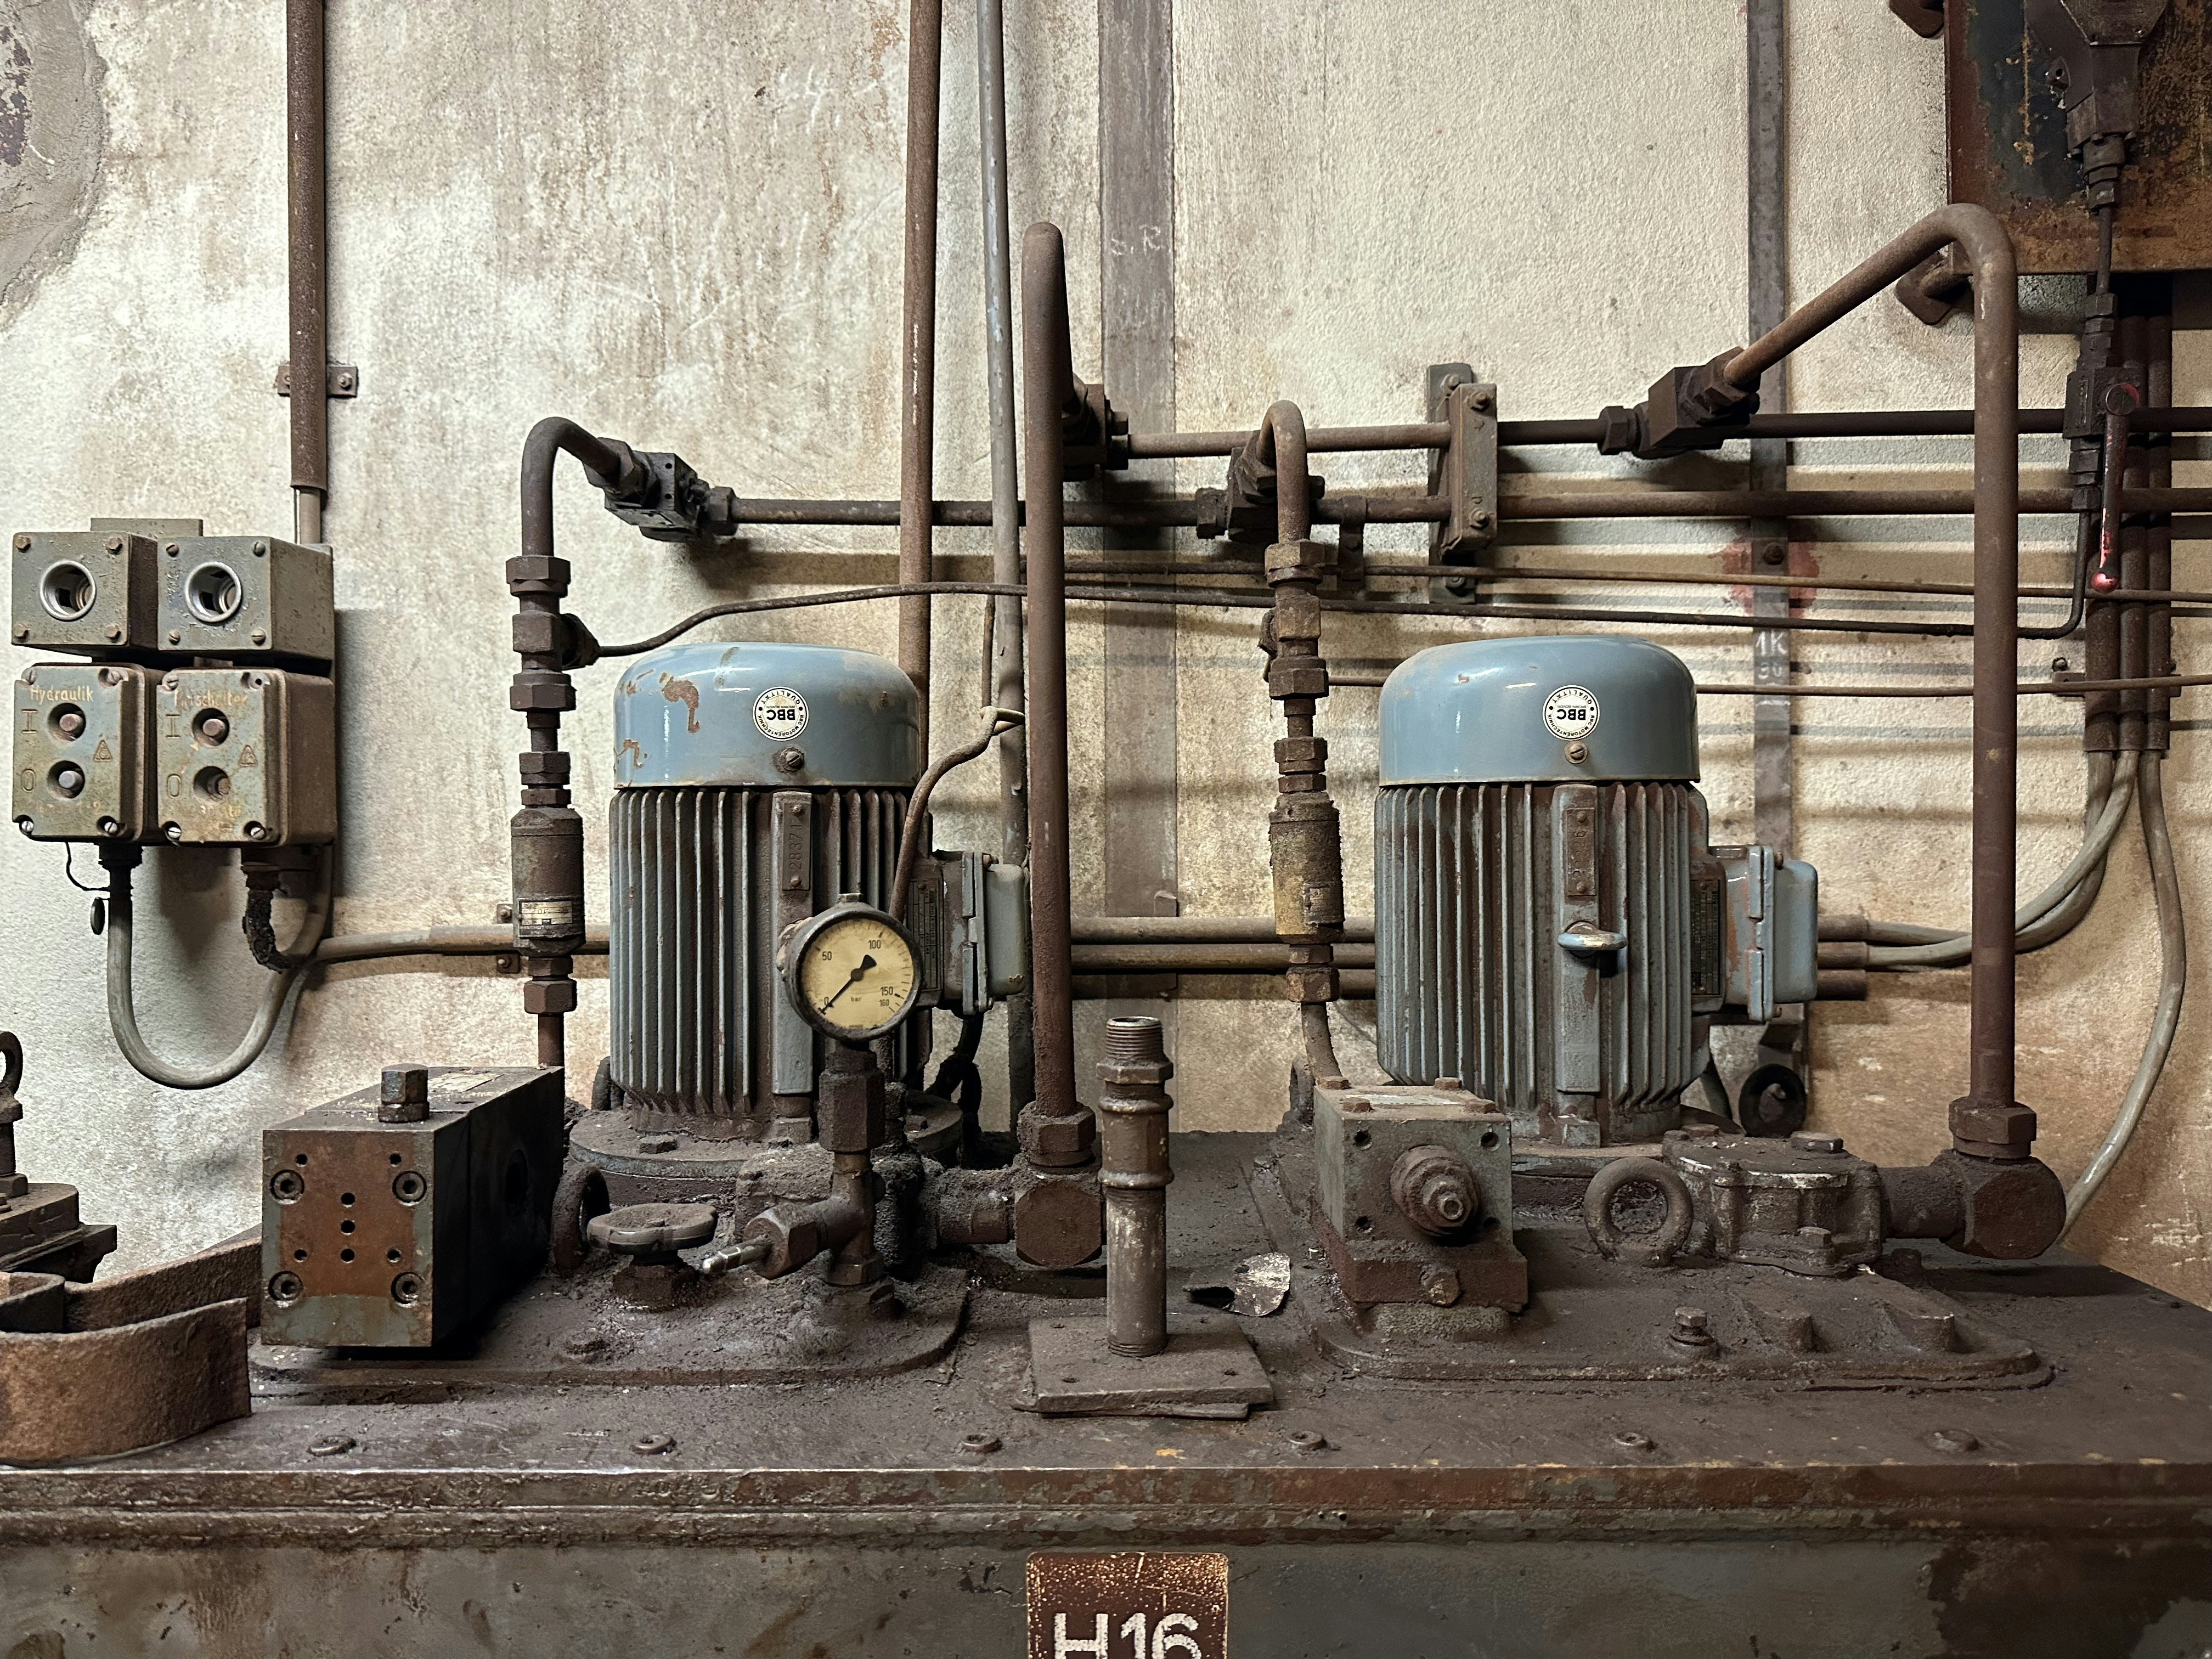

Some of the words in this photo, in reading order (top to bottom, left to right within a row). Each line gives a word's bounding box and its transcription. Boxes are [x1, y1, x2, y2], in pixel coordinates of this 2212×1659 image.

[30, 685, 94, 705] Hydraulik
[761, 690, 800, 704] QUALITÄT
[1552, 690, 1592, 704] QUALITÄT
[766, 709, 795, 720] BBC
[1556, 709, 1587, 720] BBC
[1548, 714, 1589, 736] MOTORENTECHNIK
[789, 824, 803, 870] 28371
[868, 940, 881, 949] 100
[822, 951, 832, 961] 50
[881, 986, 893, 996] 150
[823, 997, 829, 1006] 0
[879, 998, 889, 1007] 160
[1053, 1612, 1202, 1659] H16
